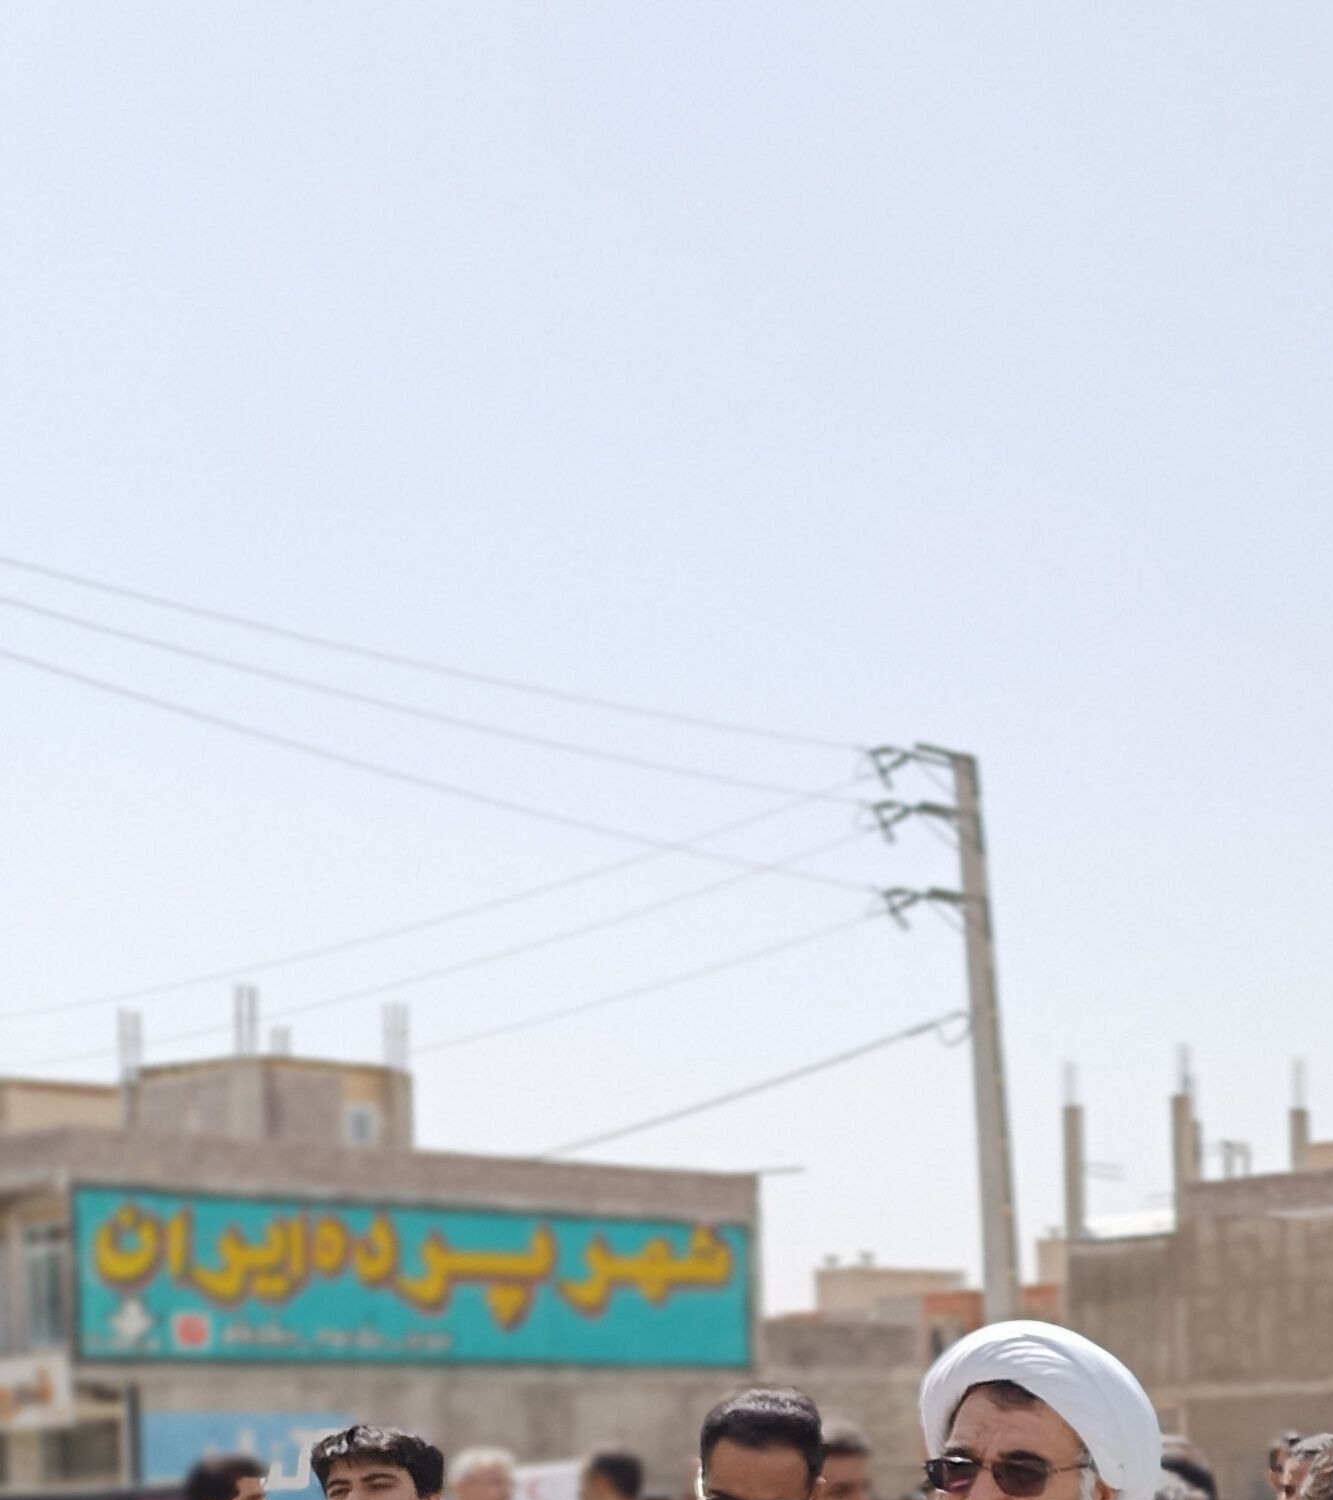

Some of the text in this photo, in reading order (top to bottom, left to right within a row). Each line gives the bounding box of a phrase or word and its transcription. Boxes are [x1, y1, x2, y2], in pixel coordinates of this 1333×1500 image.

[93, 1202, 734, 1331] شهر پرده ایران
